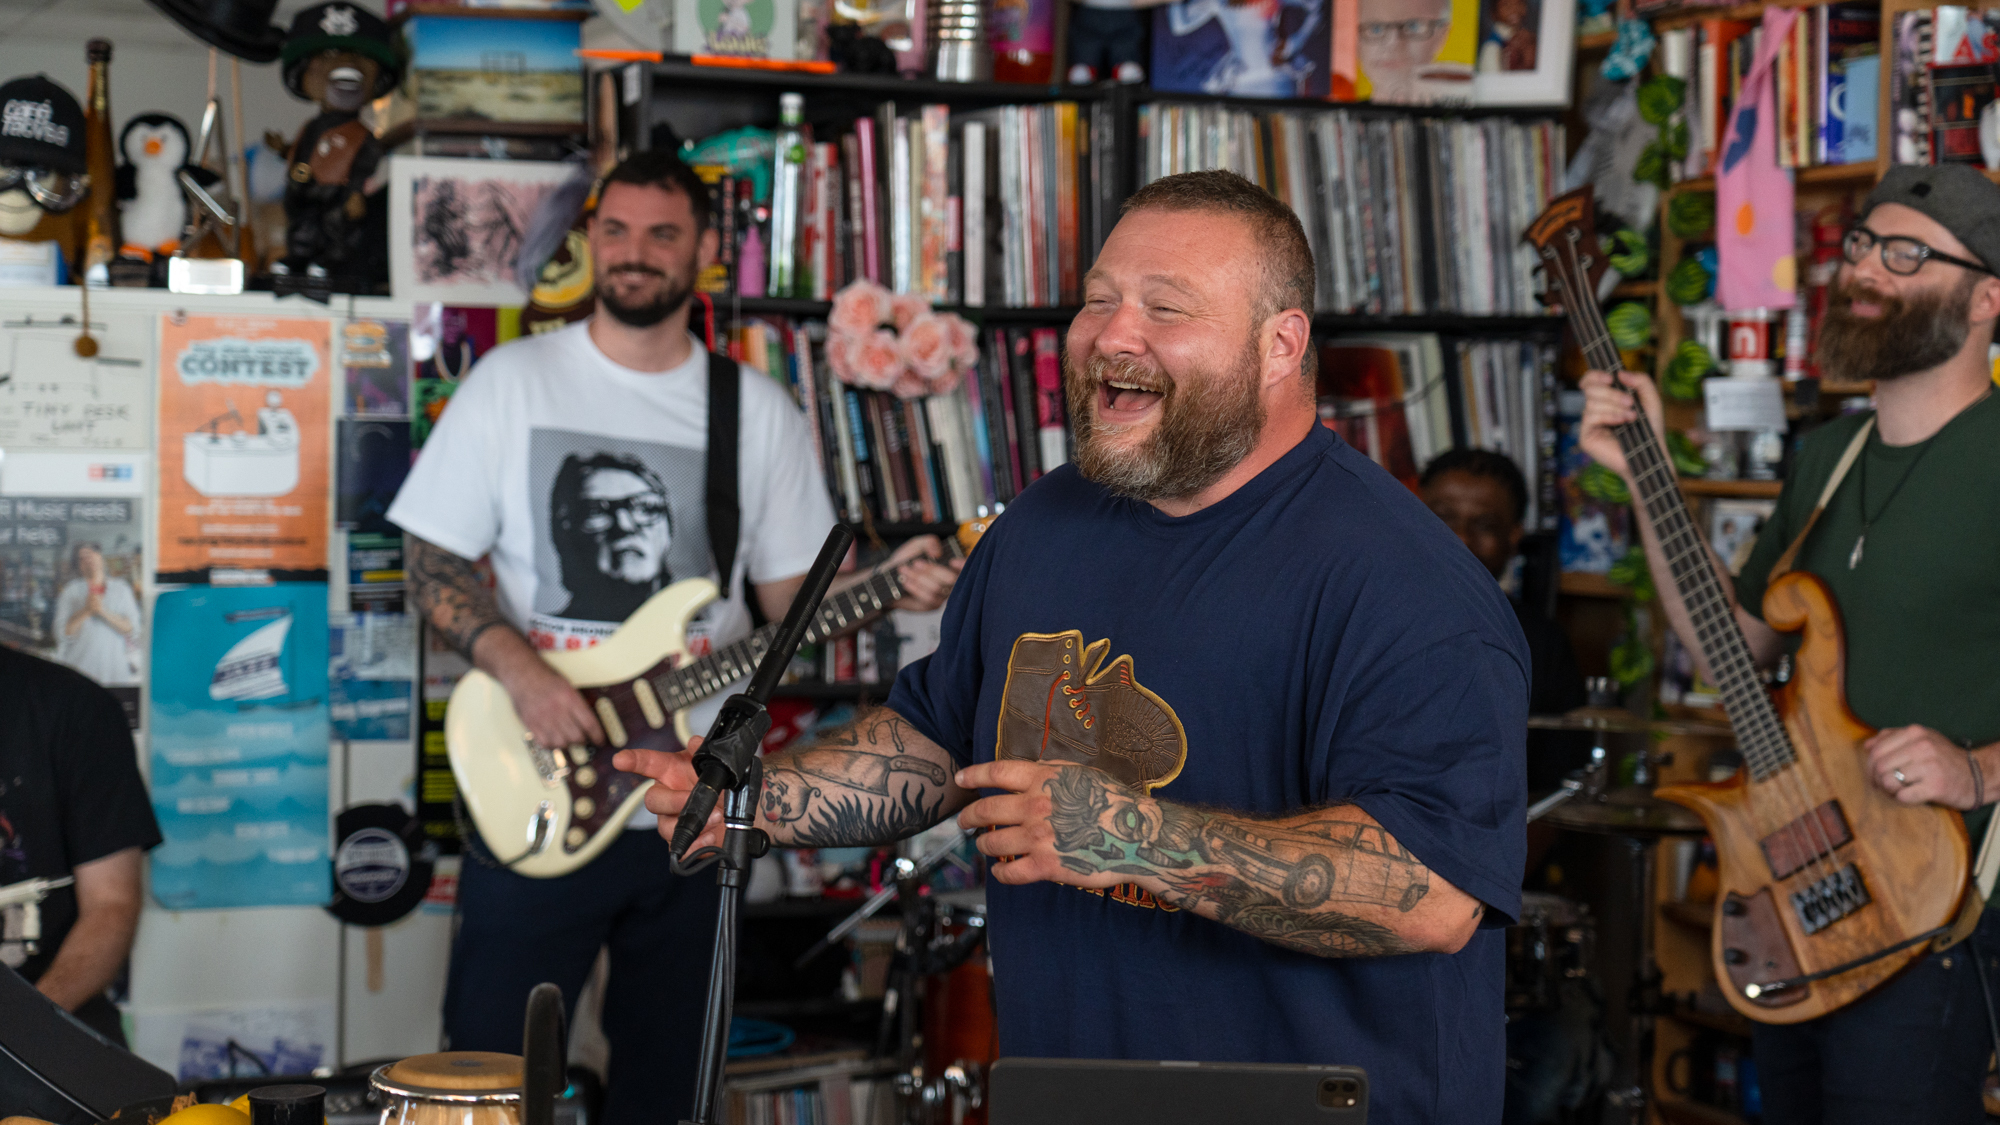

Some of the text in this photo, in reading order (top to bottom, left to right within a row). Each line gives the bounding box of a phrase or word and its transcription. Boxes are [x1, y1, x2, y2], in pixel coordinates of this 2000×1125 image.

[181, 355, 309, 379] CONTEST
[16, 499, 68, 521] Music
[72, 499, 127, 521] needs
